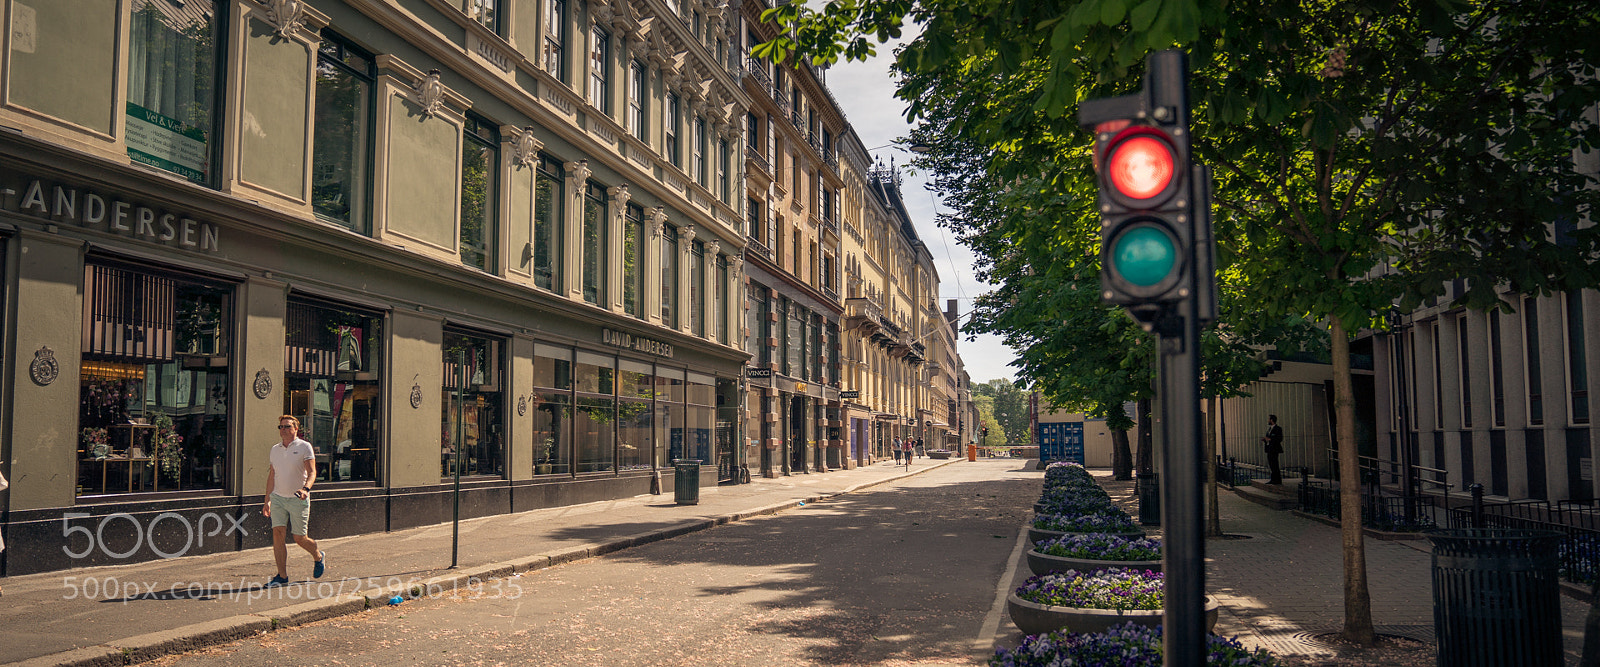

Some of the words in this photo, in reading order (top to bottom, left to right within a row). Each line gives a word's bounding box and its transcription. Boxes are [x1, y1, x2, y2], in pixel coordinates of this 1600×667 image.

[146, 111, 158, 122] Vel
[160, 117, 166, 127] &
[603, 328, 674, 358] DAVID-ANDERSEN
